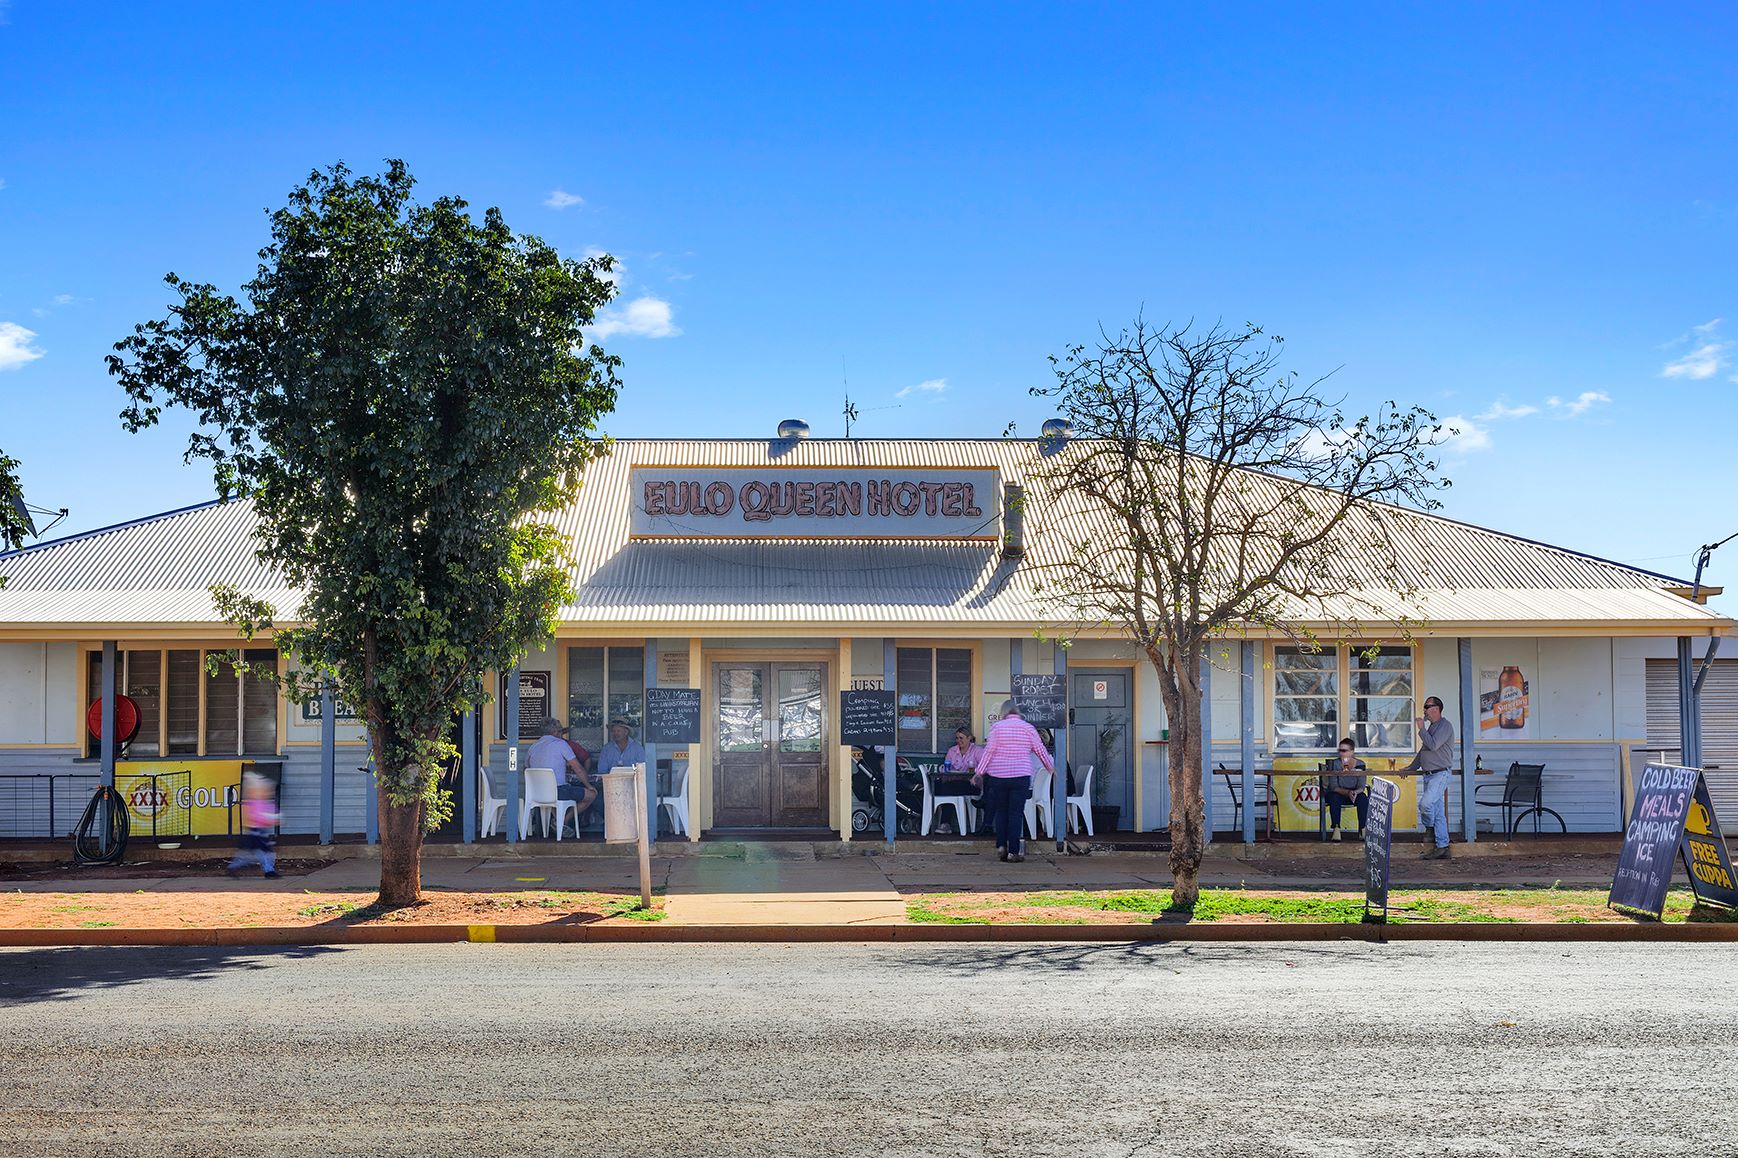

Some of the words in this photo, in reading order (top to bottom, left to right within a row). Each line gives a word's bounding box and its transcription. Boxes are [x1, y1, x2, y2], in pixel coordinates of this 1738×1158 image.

[644, 480, 735, 517] EULO
[738, 480, 861, 523] QUEEN
[867, 478, 983, 518] HOTEL
[1013, 674, 1057, 687] SUNDAY
[1021, 684, 1060, 695] ROAST
[1014, 697, 1051, 707] LUNCH
[662, 728, 679, 736] PUB
[1641, 767, 1671, 791] COLD
[1671, 768, 1697, 791] BEER
[128, 791, 169, 807] XXXX
[176, 785, 239, 809] GOLD
[1639, 791, 1686, 818] MEALS
[1626, 818, 1680, 842] CAMPING
[1636, 843, 1654, 862] ICE
[1688, 840, 1721, 866] FREE
[1691, 860, 1734, 891] CUPPA
